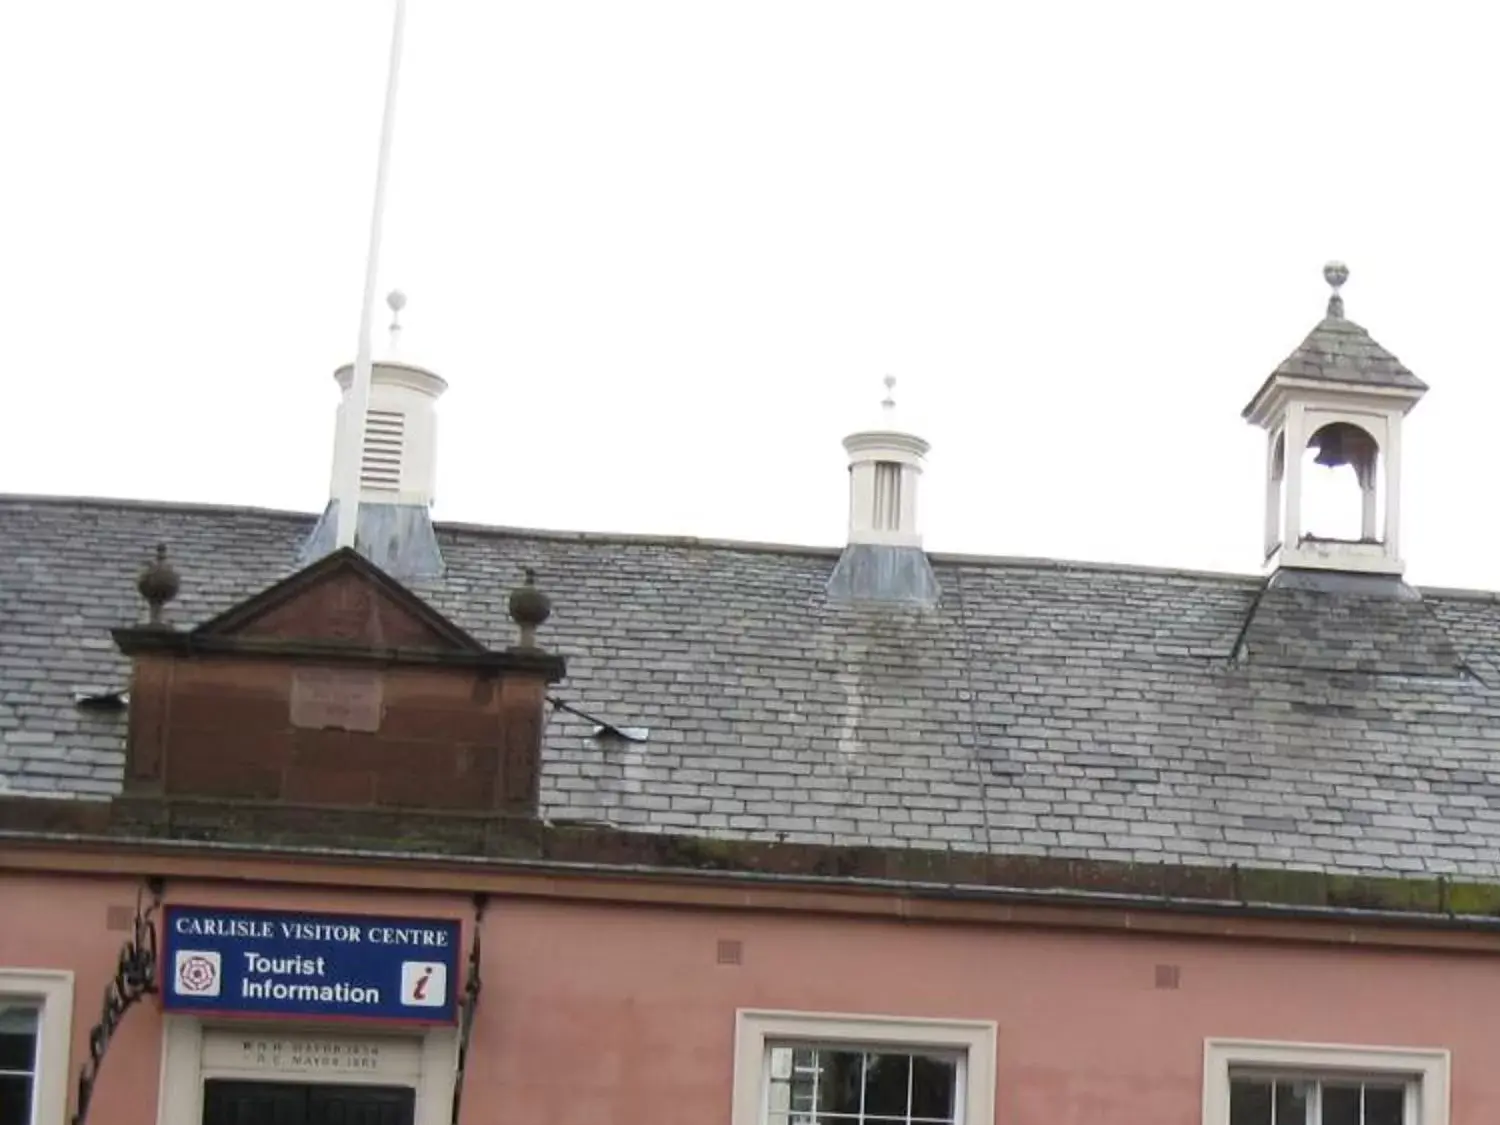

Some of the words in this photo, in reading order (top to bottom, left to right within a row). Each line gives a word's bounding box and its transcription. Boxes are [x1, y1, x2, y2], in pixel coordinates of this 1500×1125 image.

[176, 917, 274, 938] CARLISLE
[281, 922, 361, 943] VISITOR
[368, 928, 449, 947] CENTRE
[243, 952, 325, 976] Tourist
[241, 979, 380, 1004] Information
